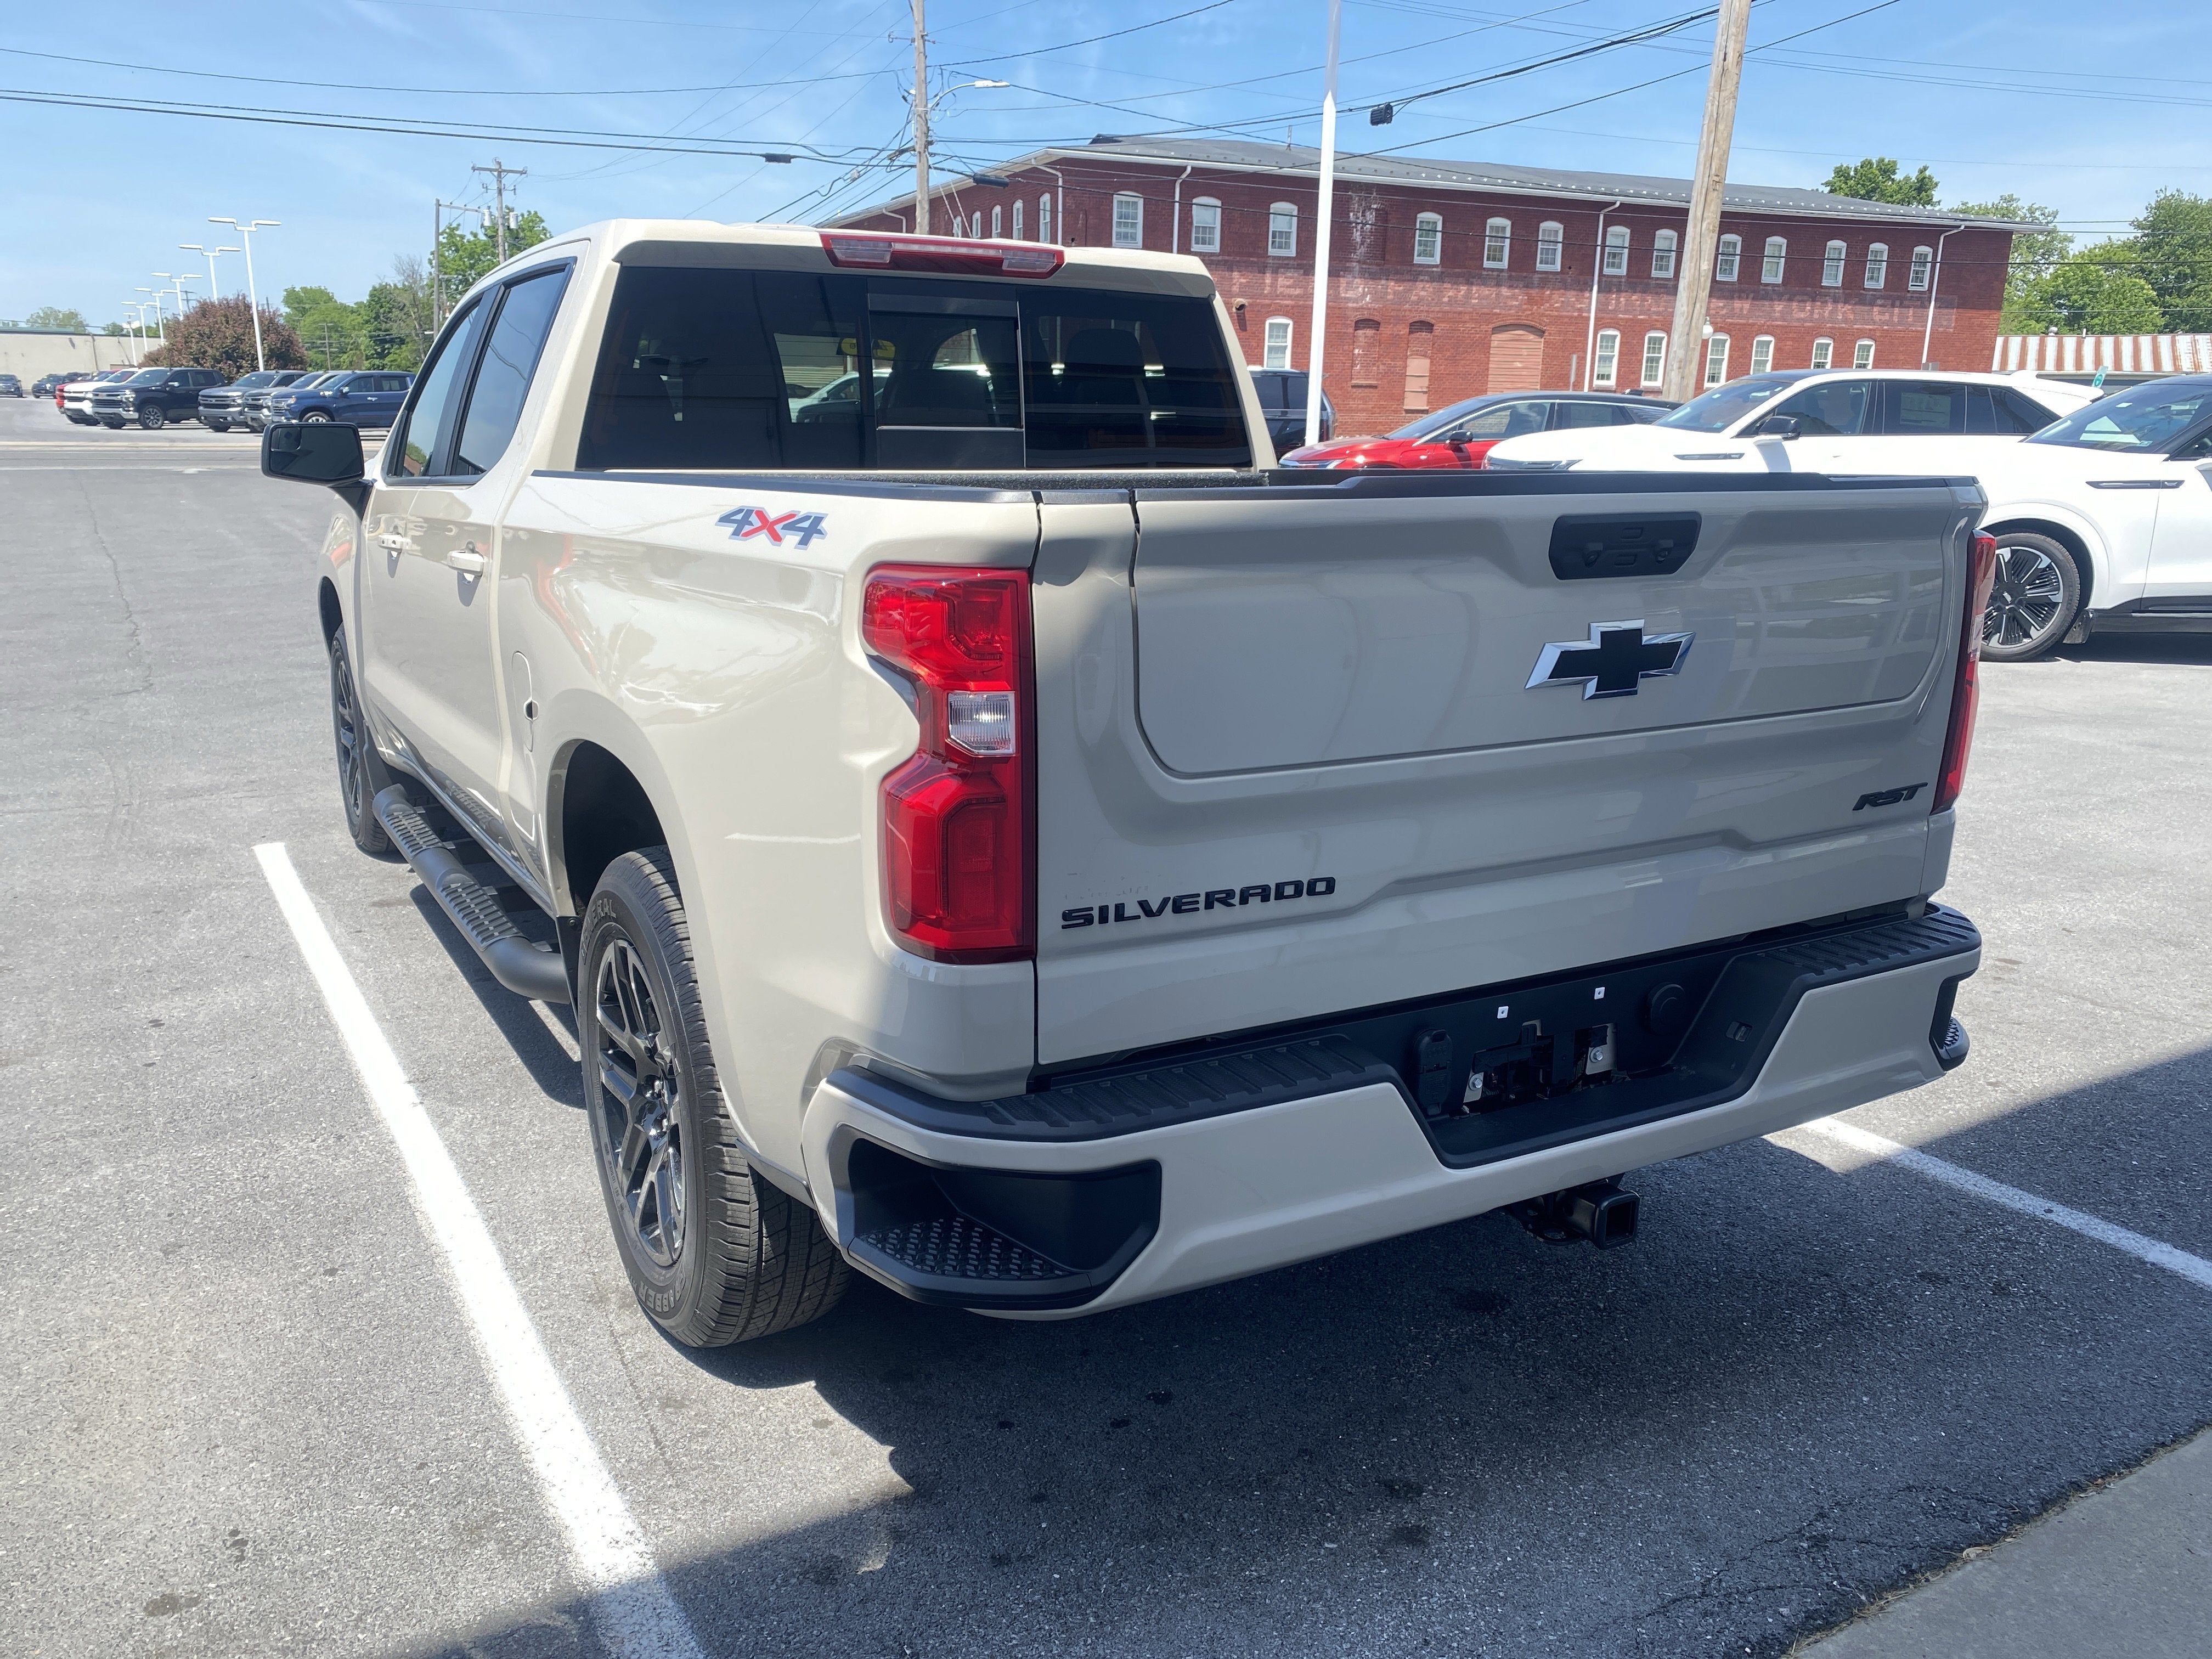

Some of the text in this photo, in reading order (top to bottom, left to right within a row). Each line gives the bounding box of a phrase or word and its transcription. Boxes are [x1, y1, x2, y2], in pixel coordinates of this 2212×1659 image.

[1772, 294, 1859, 319] YORK
[1852, 782, 1928, 811] RST
[1061, 876, 1336, 929] SILVERADO
